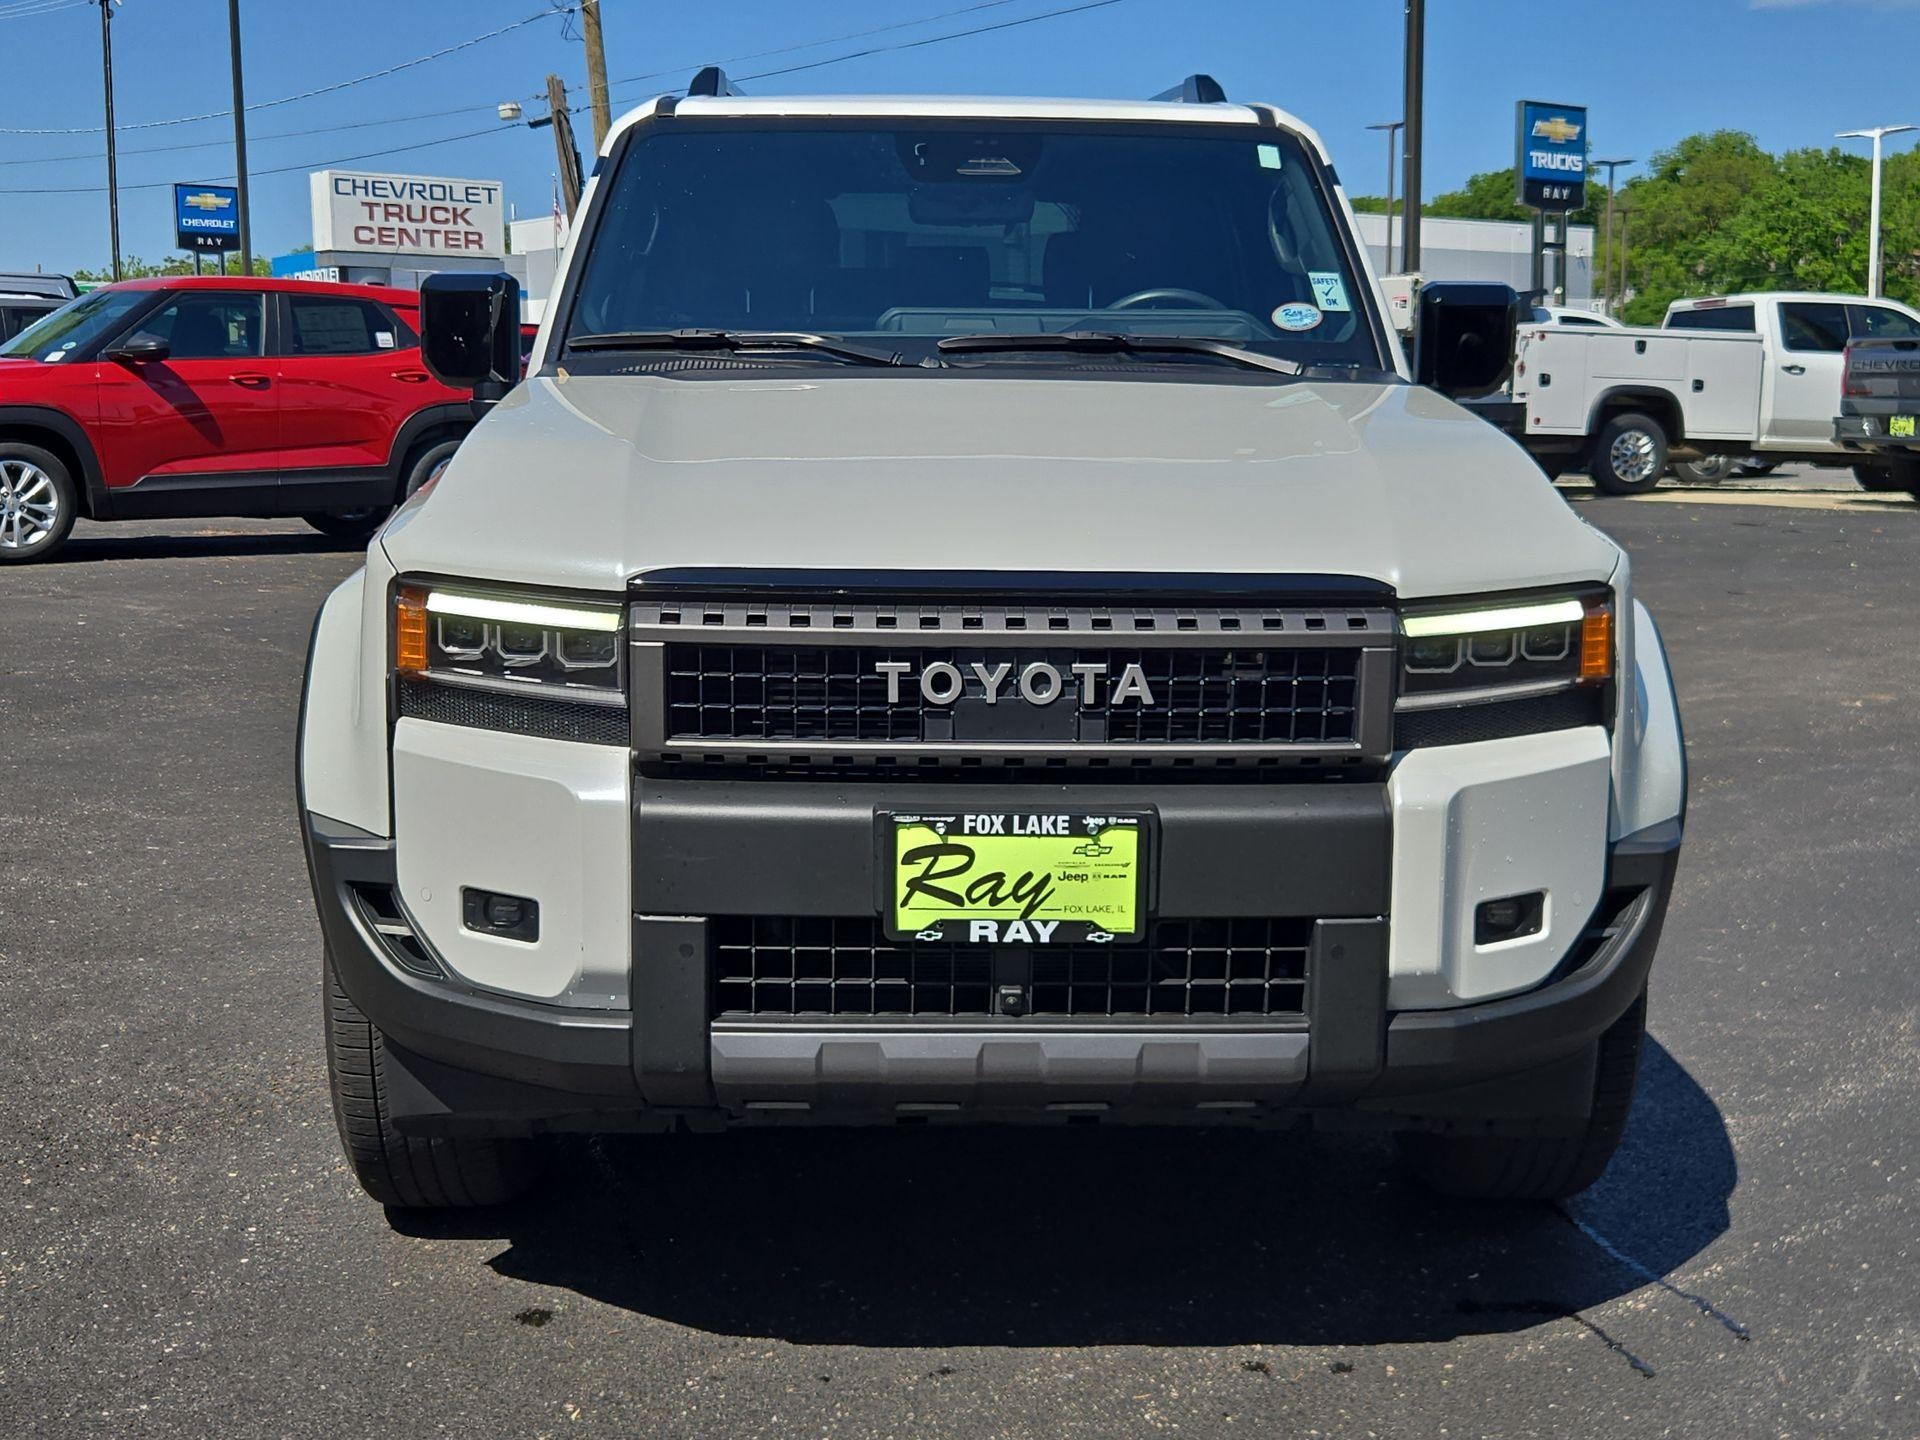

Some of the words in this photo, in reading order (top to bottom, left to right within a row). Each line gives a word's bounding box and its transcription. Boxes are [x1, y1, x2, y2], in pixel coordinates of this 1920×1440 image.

[1530, 151, 1583, 172] TRUCKS
[334, 177, 498, 205] CHEVROLET
[1543, 186, 1569, 200] RAY
[361, 201, 475, 227] TRUCK
[182, 218, 235, 229] CHEVROLET
[197, 237, 223, 246] RAY
[354, 225, 484, 250] CENTER
[1312, 277, 1339, 286] SAFETY
[1326, 298, 1340, 306] OK
[875, 662, 1155, 705] TOYOTA
[963, 815, 1005, 835] FOX
[1013, 815, 1070, 835] LAKE
[1082, 815, 1106, 825] Jeep
[900, 842, 1056, 920] Ray
[1058, 871, 1089, 883] Jeep
[1063, 905, 1083, 913] FOX
[1086, 905, 1115, 914] LAKE,
[1118, 905, 1127, 913] IL
[969, 920, 1060, 943] RAY
